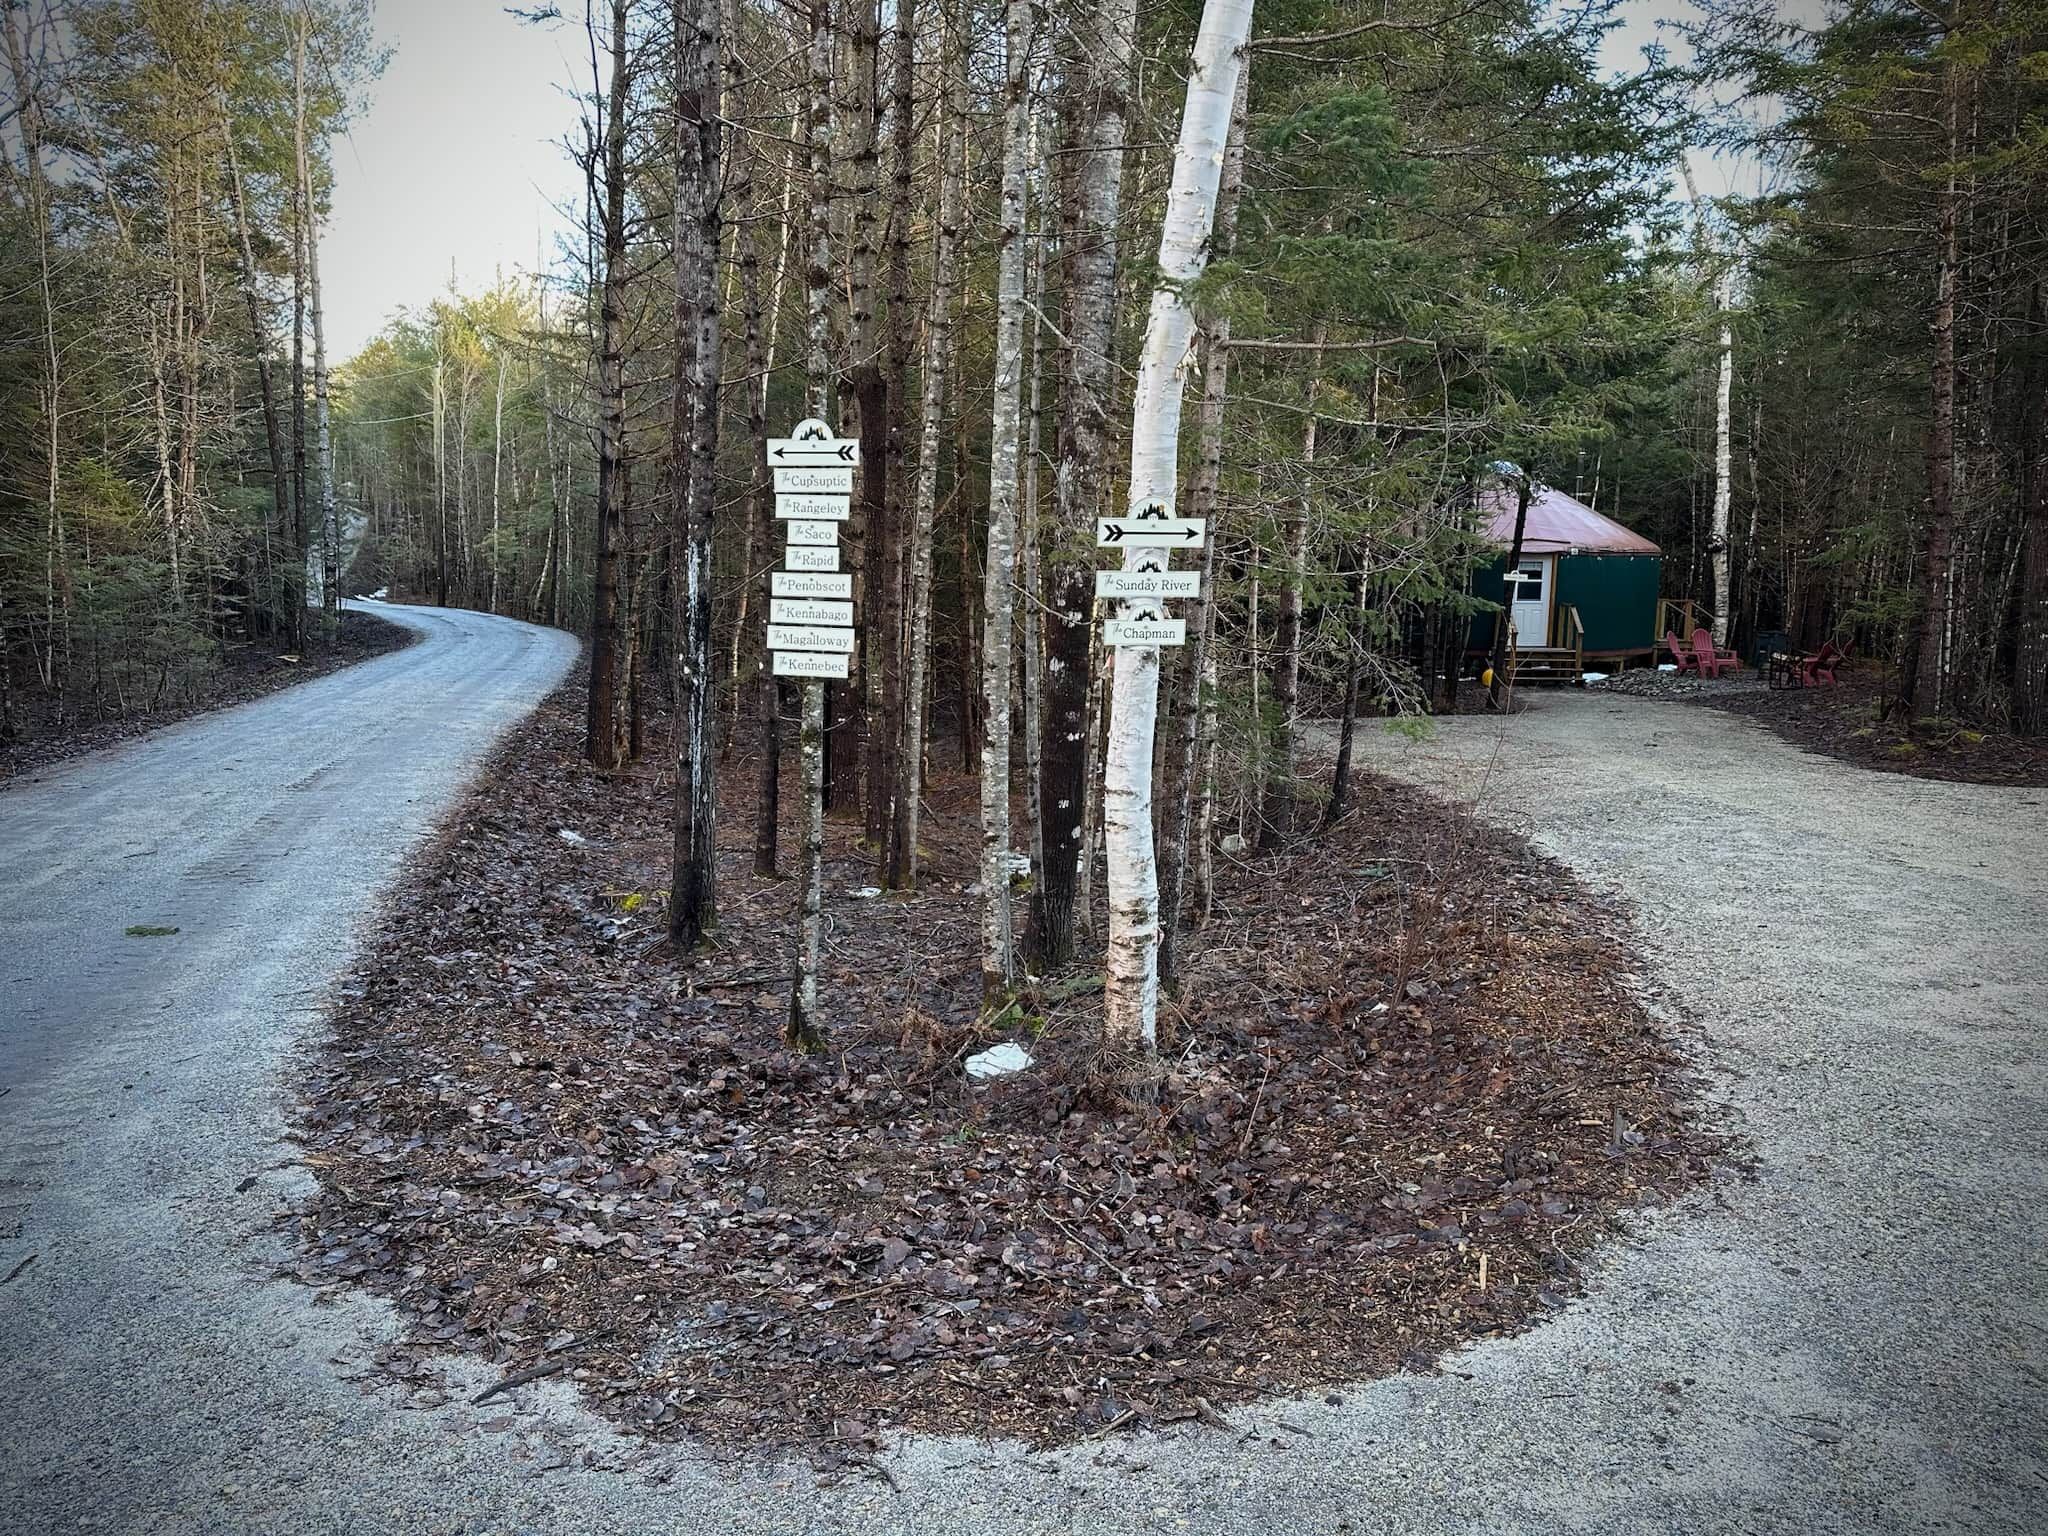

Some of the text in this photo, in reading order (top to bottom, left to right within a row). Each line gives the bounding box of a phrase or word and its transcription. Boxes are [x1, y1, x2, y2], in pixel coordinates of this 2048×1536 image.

[791, 474, 847, 488] Cupsuptic
[792, 502, 845, 515] Rangeley
[804, 528, 832, 539] Saco
[802, 555, 834, 567] Rapid
[787, 579, 846, 592] Penobscot
[1104, 574, 1192, 592] The Sunday River
[786, 607, 848, 621] Kennabago
[1112, 623, 1176, 640] The Chapman
[783, 633, 849, 648] Magalloway
[788, 659, 844, 672] Kennebec
